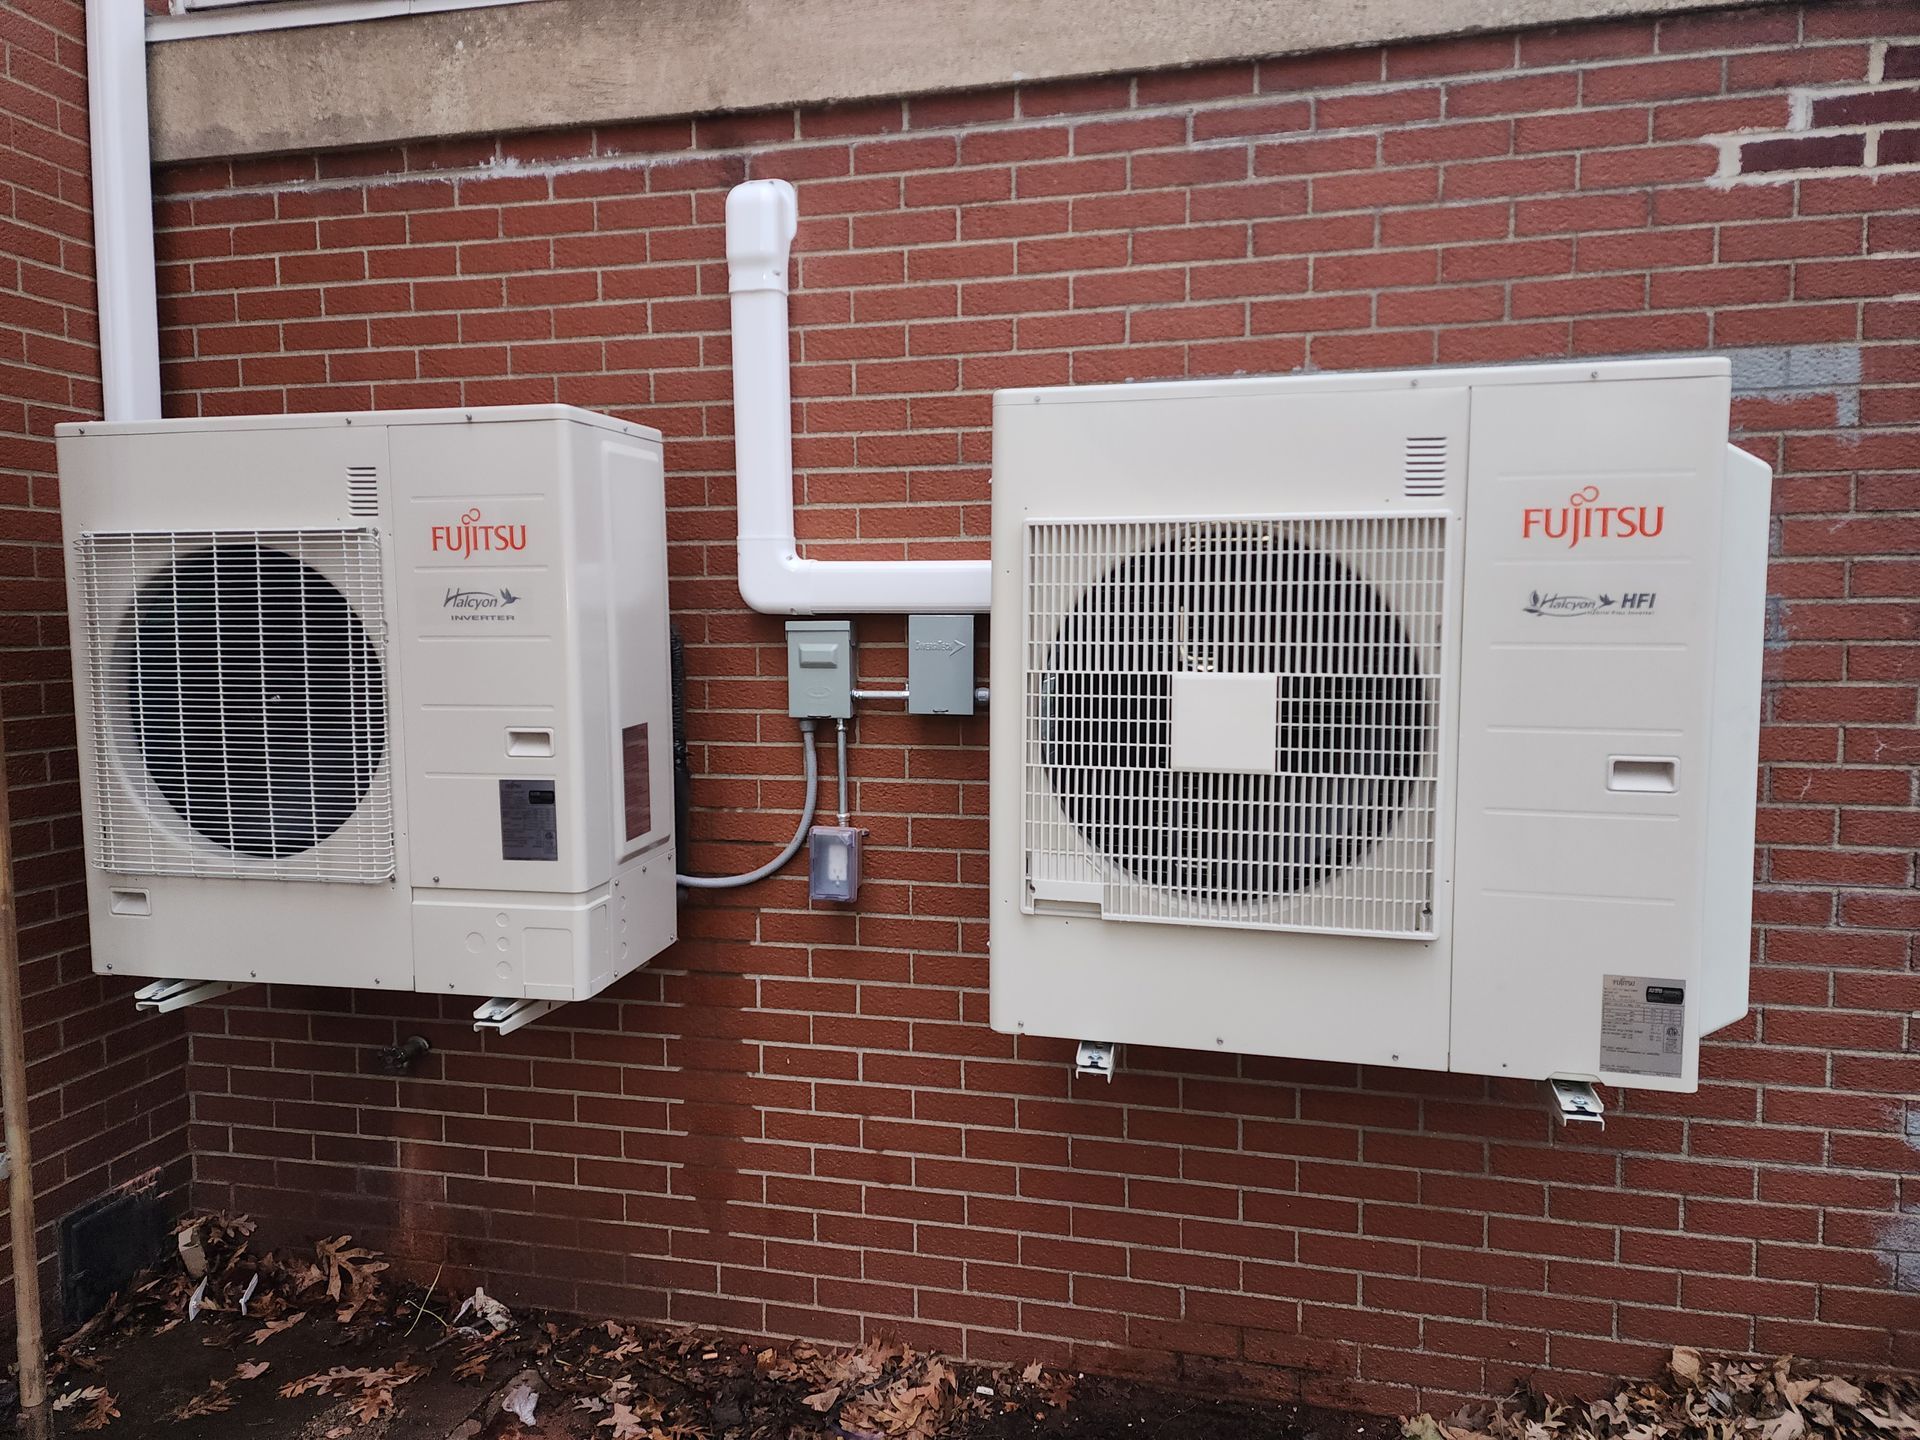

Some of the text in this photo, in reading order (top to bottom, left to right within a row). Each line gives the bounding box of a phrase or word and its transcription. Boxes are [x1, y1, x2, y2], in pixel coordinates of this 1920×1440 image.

[432, 508, 526, 560] FUJITSU
[1523, 486, 1664, 549] FUJITSU
[443, 588, 498, 610] Halcyon
[1540, 593, 1656, 611] Halcyon HFI
